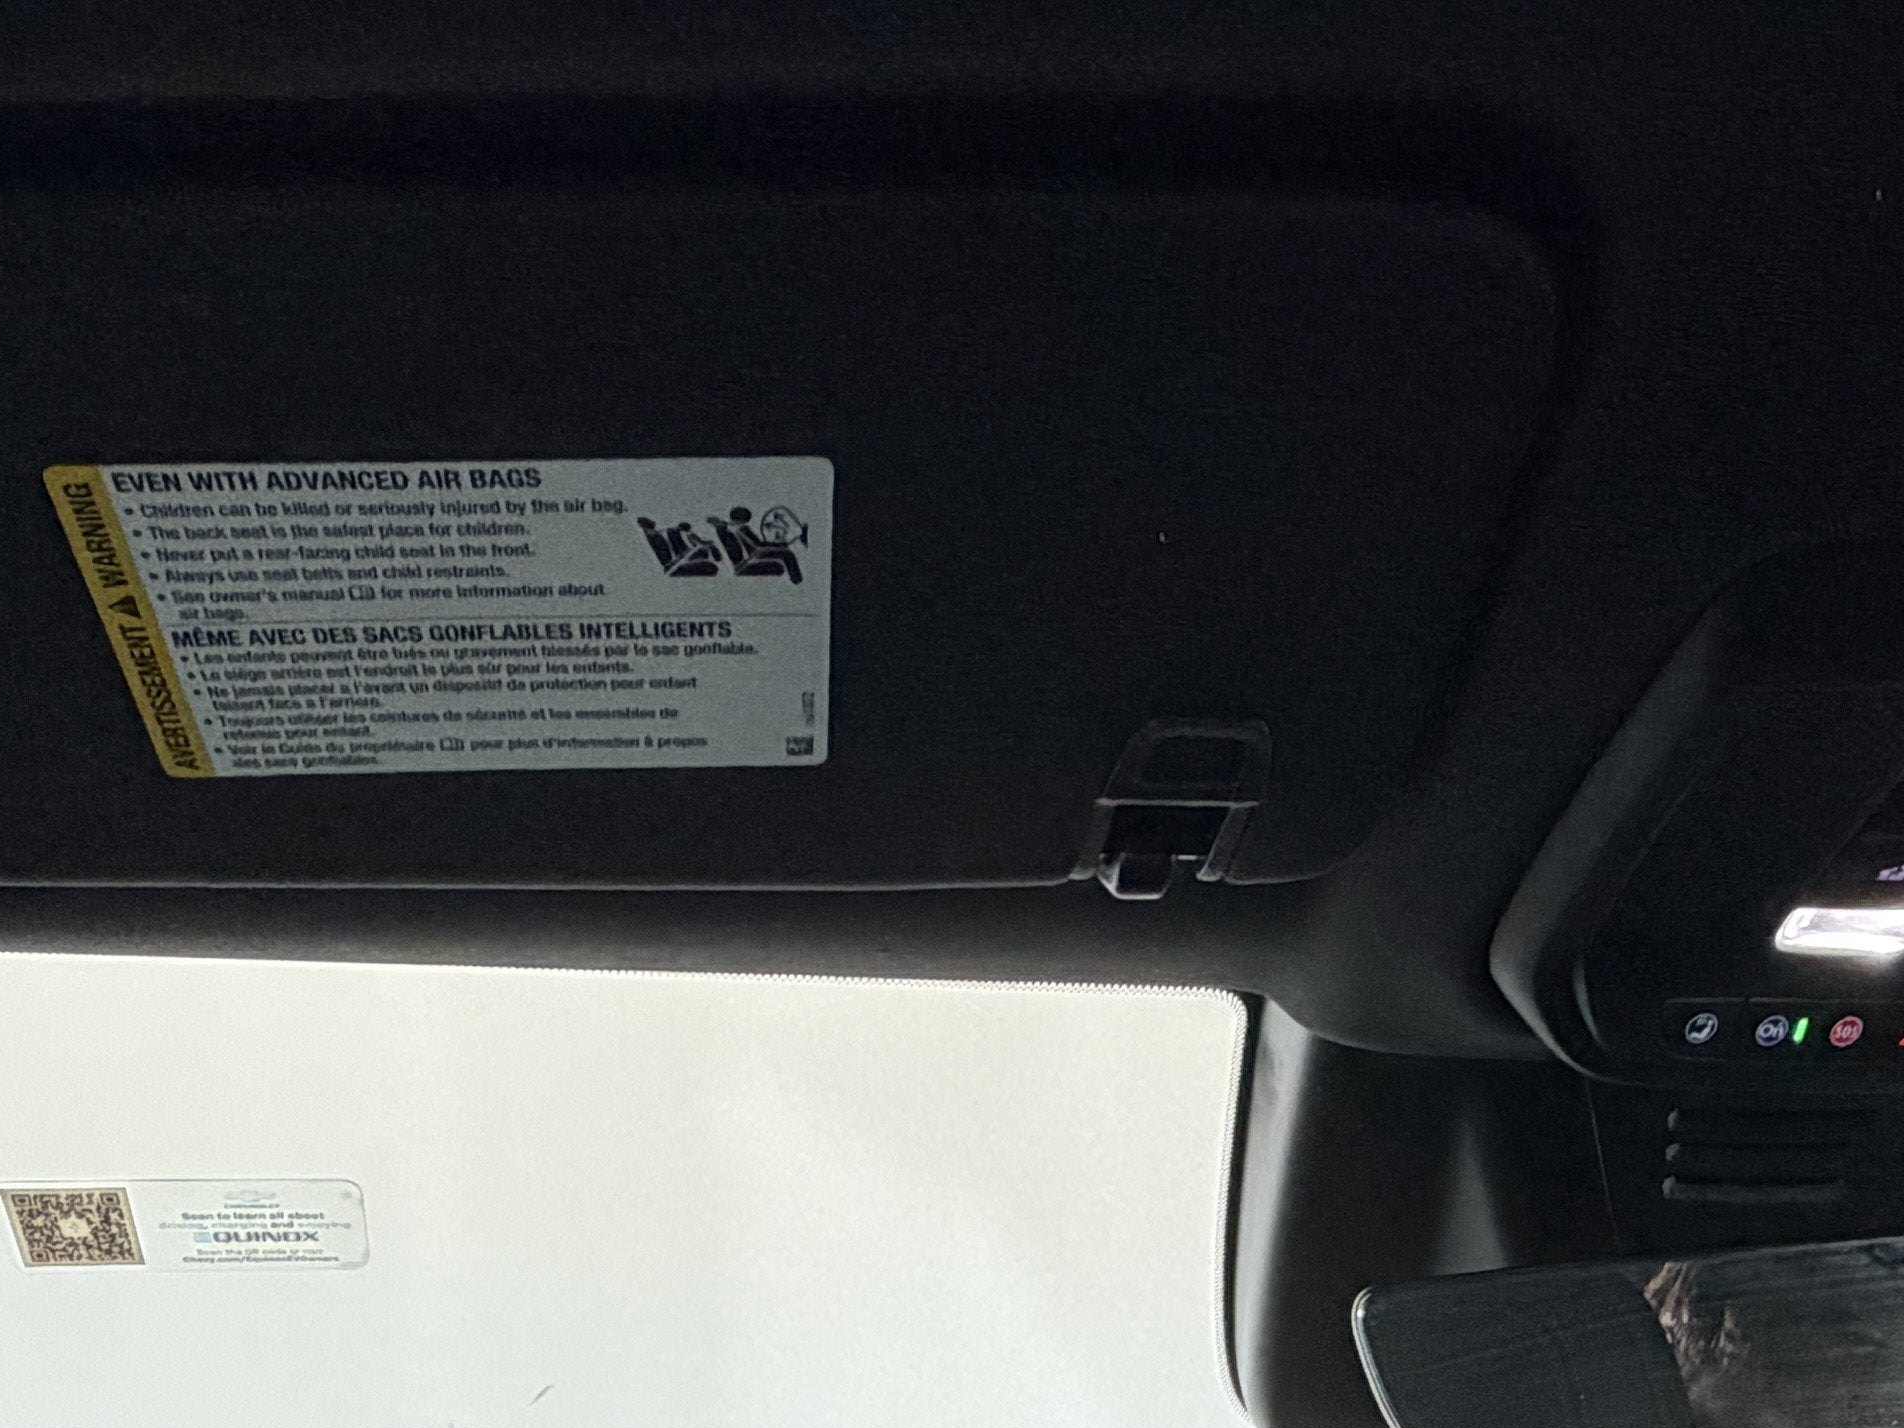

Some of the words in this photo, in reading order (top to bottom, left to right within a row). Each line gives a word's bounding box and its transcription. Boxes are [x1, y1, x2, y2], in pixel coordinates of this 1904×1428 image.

[112, 472, 181, 493] EVEN
[188, 471, 257, 492] WITH
[267, 470, 409, 491] ADVANCED
[418, 469, 462, 490] AIR
[469, 468, 542, 489] BAGS
[63, 482, 129, 588] WARNING
[172, 627, 243, 648] MÊME
[249, 627, 306, 646] AVEC
[312, 626, 357, 644] DES
[362, 624, 423, 643] SACS
[429, 622, 573, 642] GONFLABLES
[580, 620, 733, 640] INTELLIGENTS
[118, 623, 199, 771] AVERTISSEMENT
[1832, 1025, 1858, 1039] SOS
